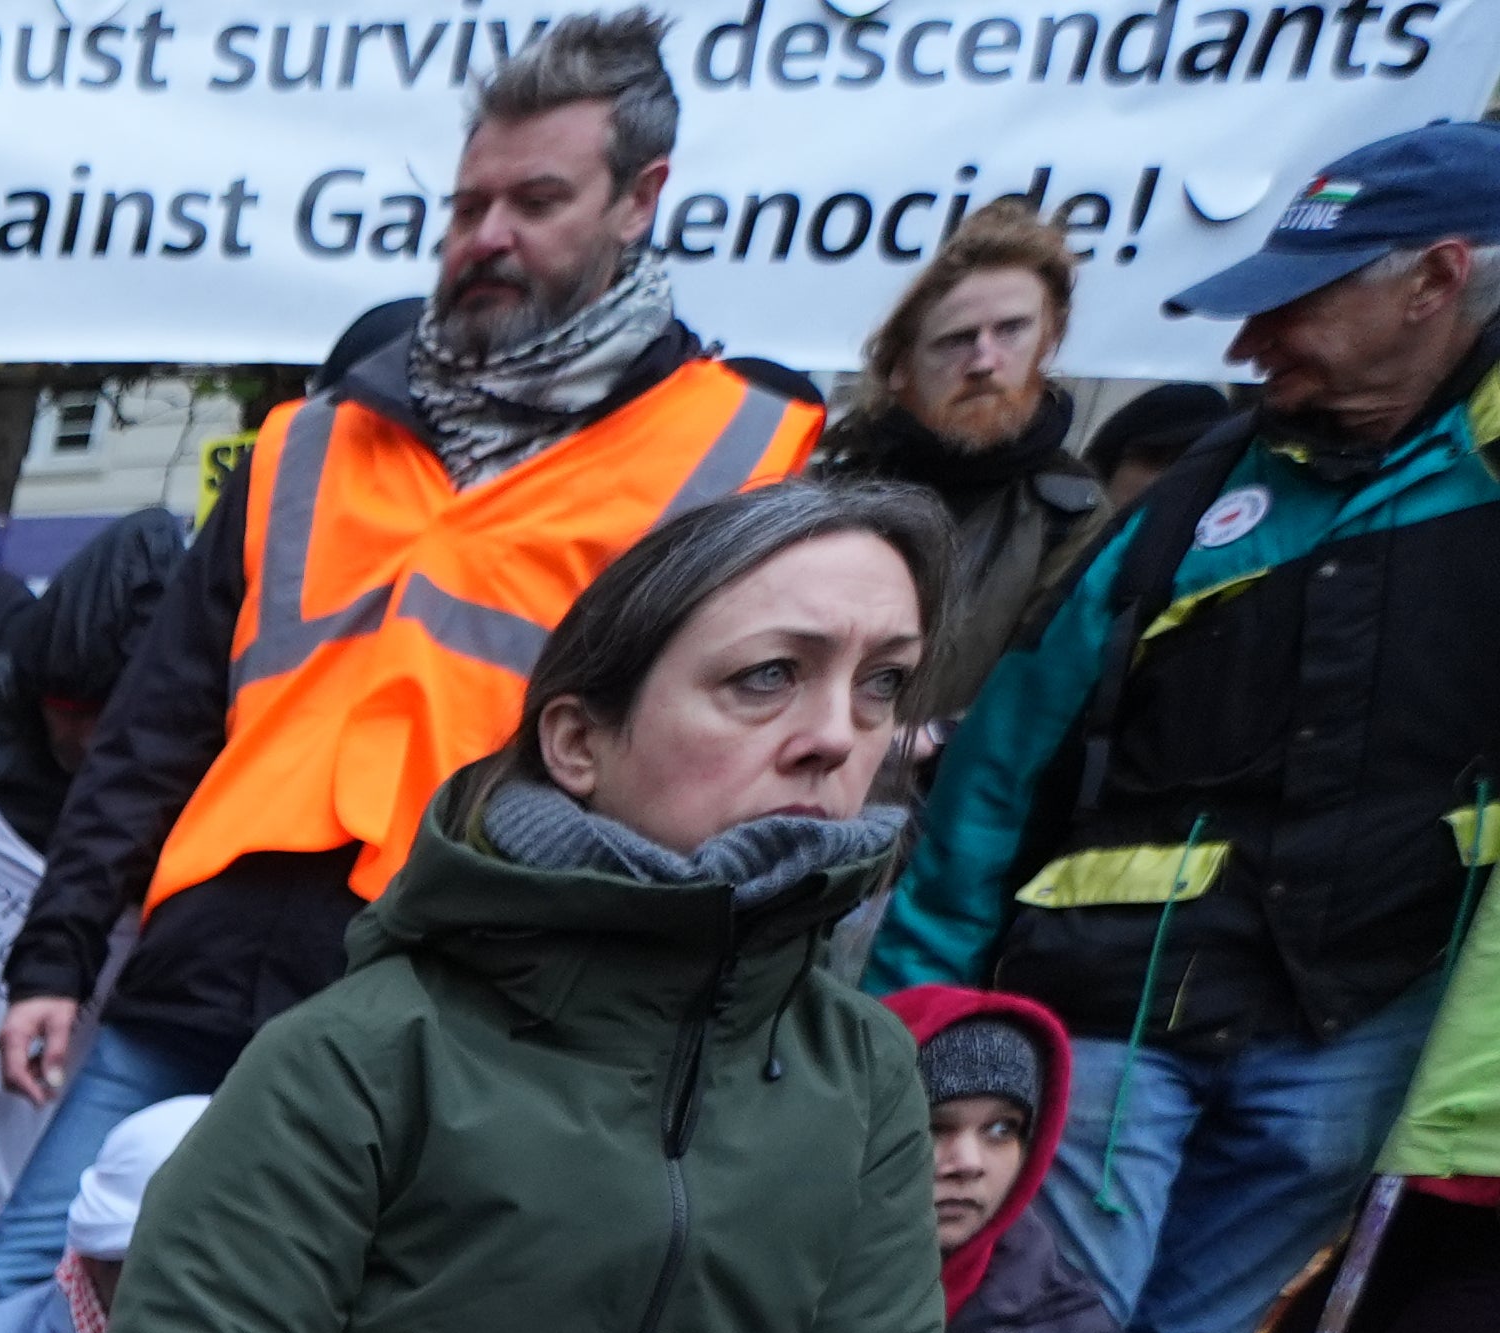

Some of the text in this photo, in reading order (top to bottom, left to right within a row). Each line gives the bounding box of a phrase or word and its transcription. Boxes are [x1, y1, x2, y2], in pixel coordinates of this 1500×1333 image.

[209, 0, 548, 91] surviv
[694, 0, 1442, 90] descendants
[295, 166, 456, 262] Ga
[663, 164, 1162, 265] enocie!
[1280, 203, 1343, 231] STINE
